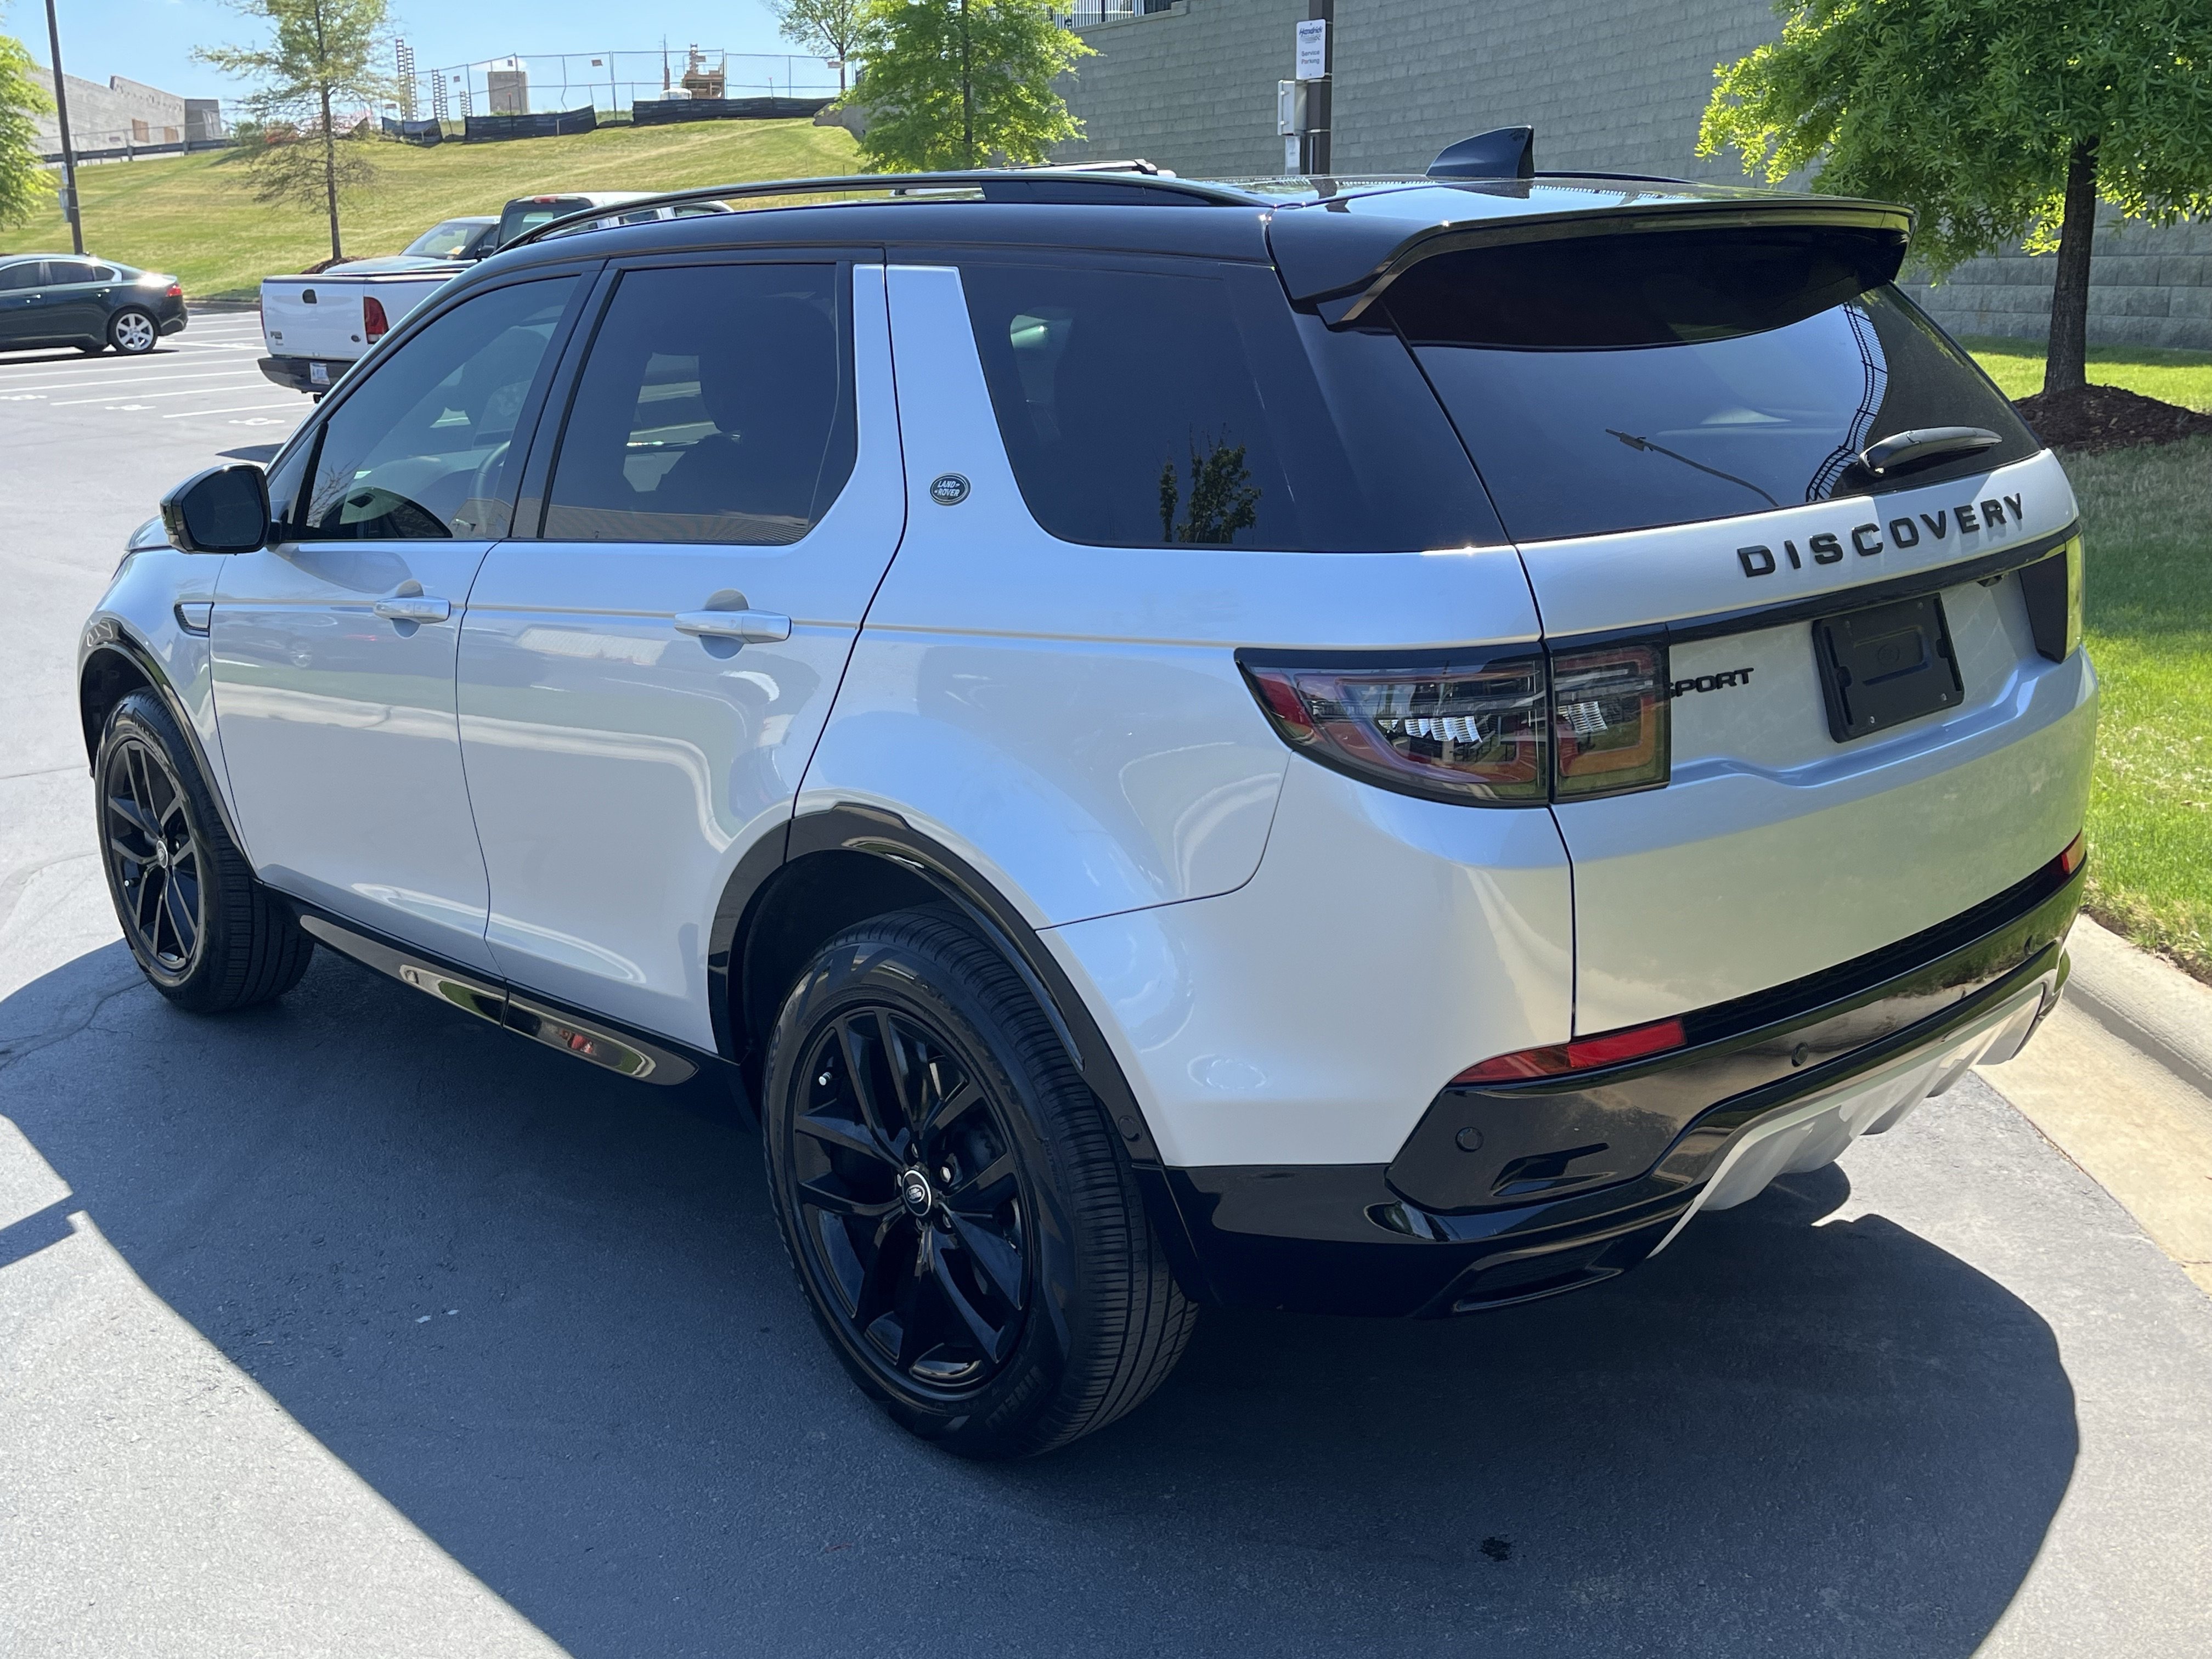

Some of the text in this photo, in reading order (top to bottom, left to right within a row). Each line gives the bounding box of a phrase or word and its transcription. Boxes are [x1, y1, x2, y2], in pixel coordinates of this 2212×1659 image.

[1299, 26, 1323, 37] Hendrick
[937, 488, 960, 496] ROVER
[1737, 493, 2023, 578] DISCOVERY
